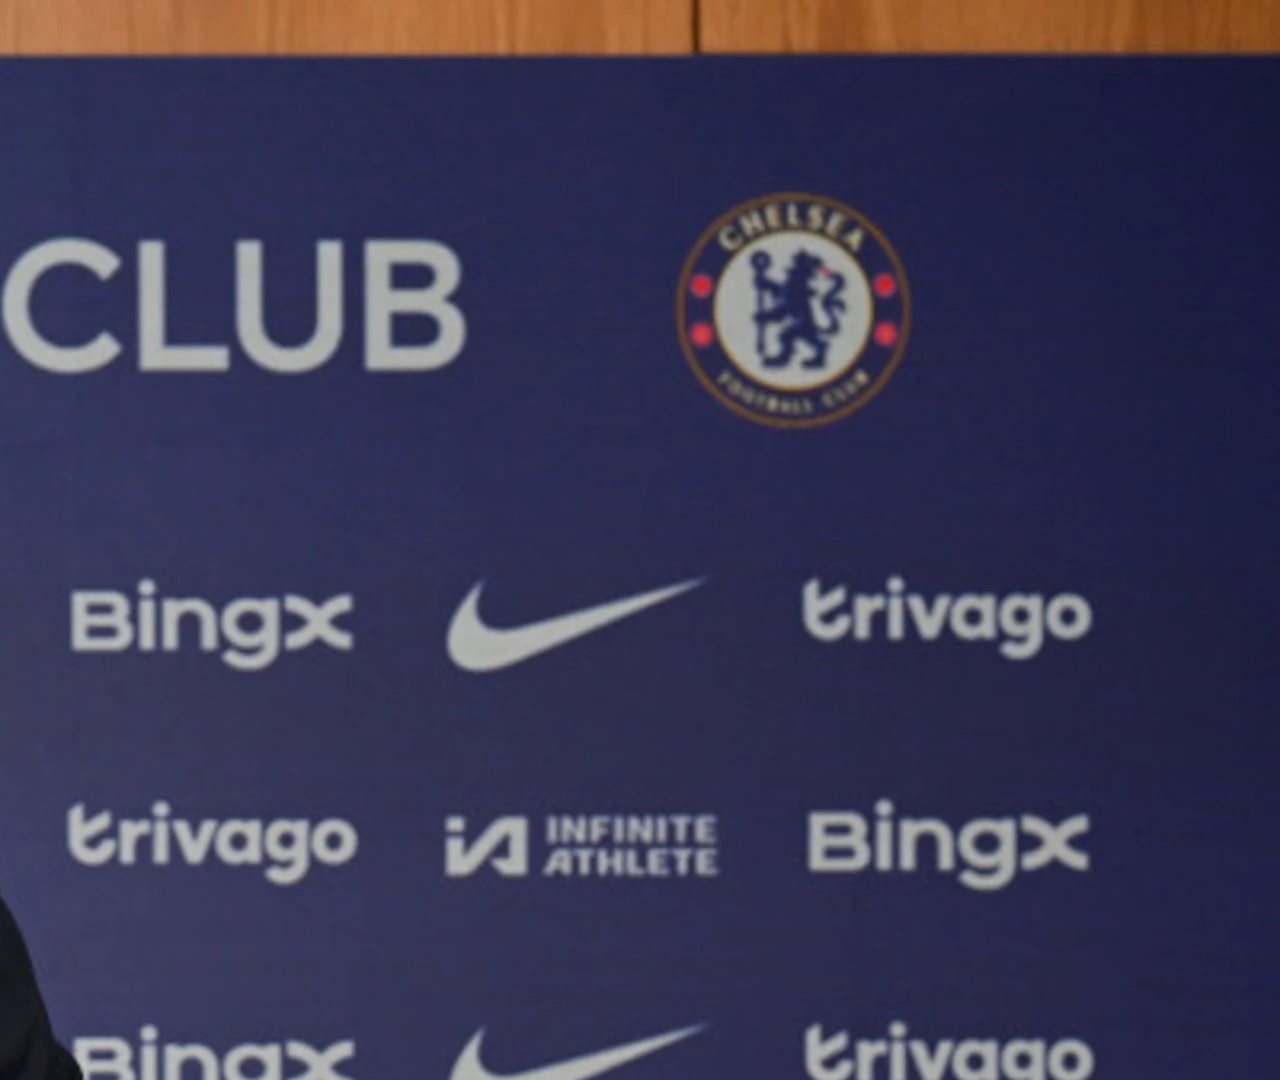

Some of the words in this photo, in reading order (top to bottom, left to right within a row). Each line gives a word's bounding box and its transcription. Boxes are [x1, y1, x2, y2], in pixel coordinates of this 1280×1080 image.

[717, 203, 864, 252] CHELSEA
[2, 239, 465, 373] CLUB
[803, 577, 1091, 659] trivago
[68, 802, 357, 884] trivago
[544, 848, 717, 876] ATHLETE
[547, 816, 714, 843] INFINITE
